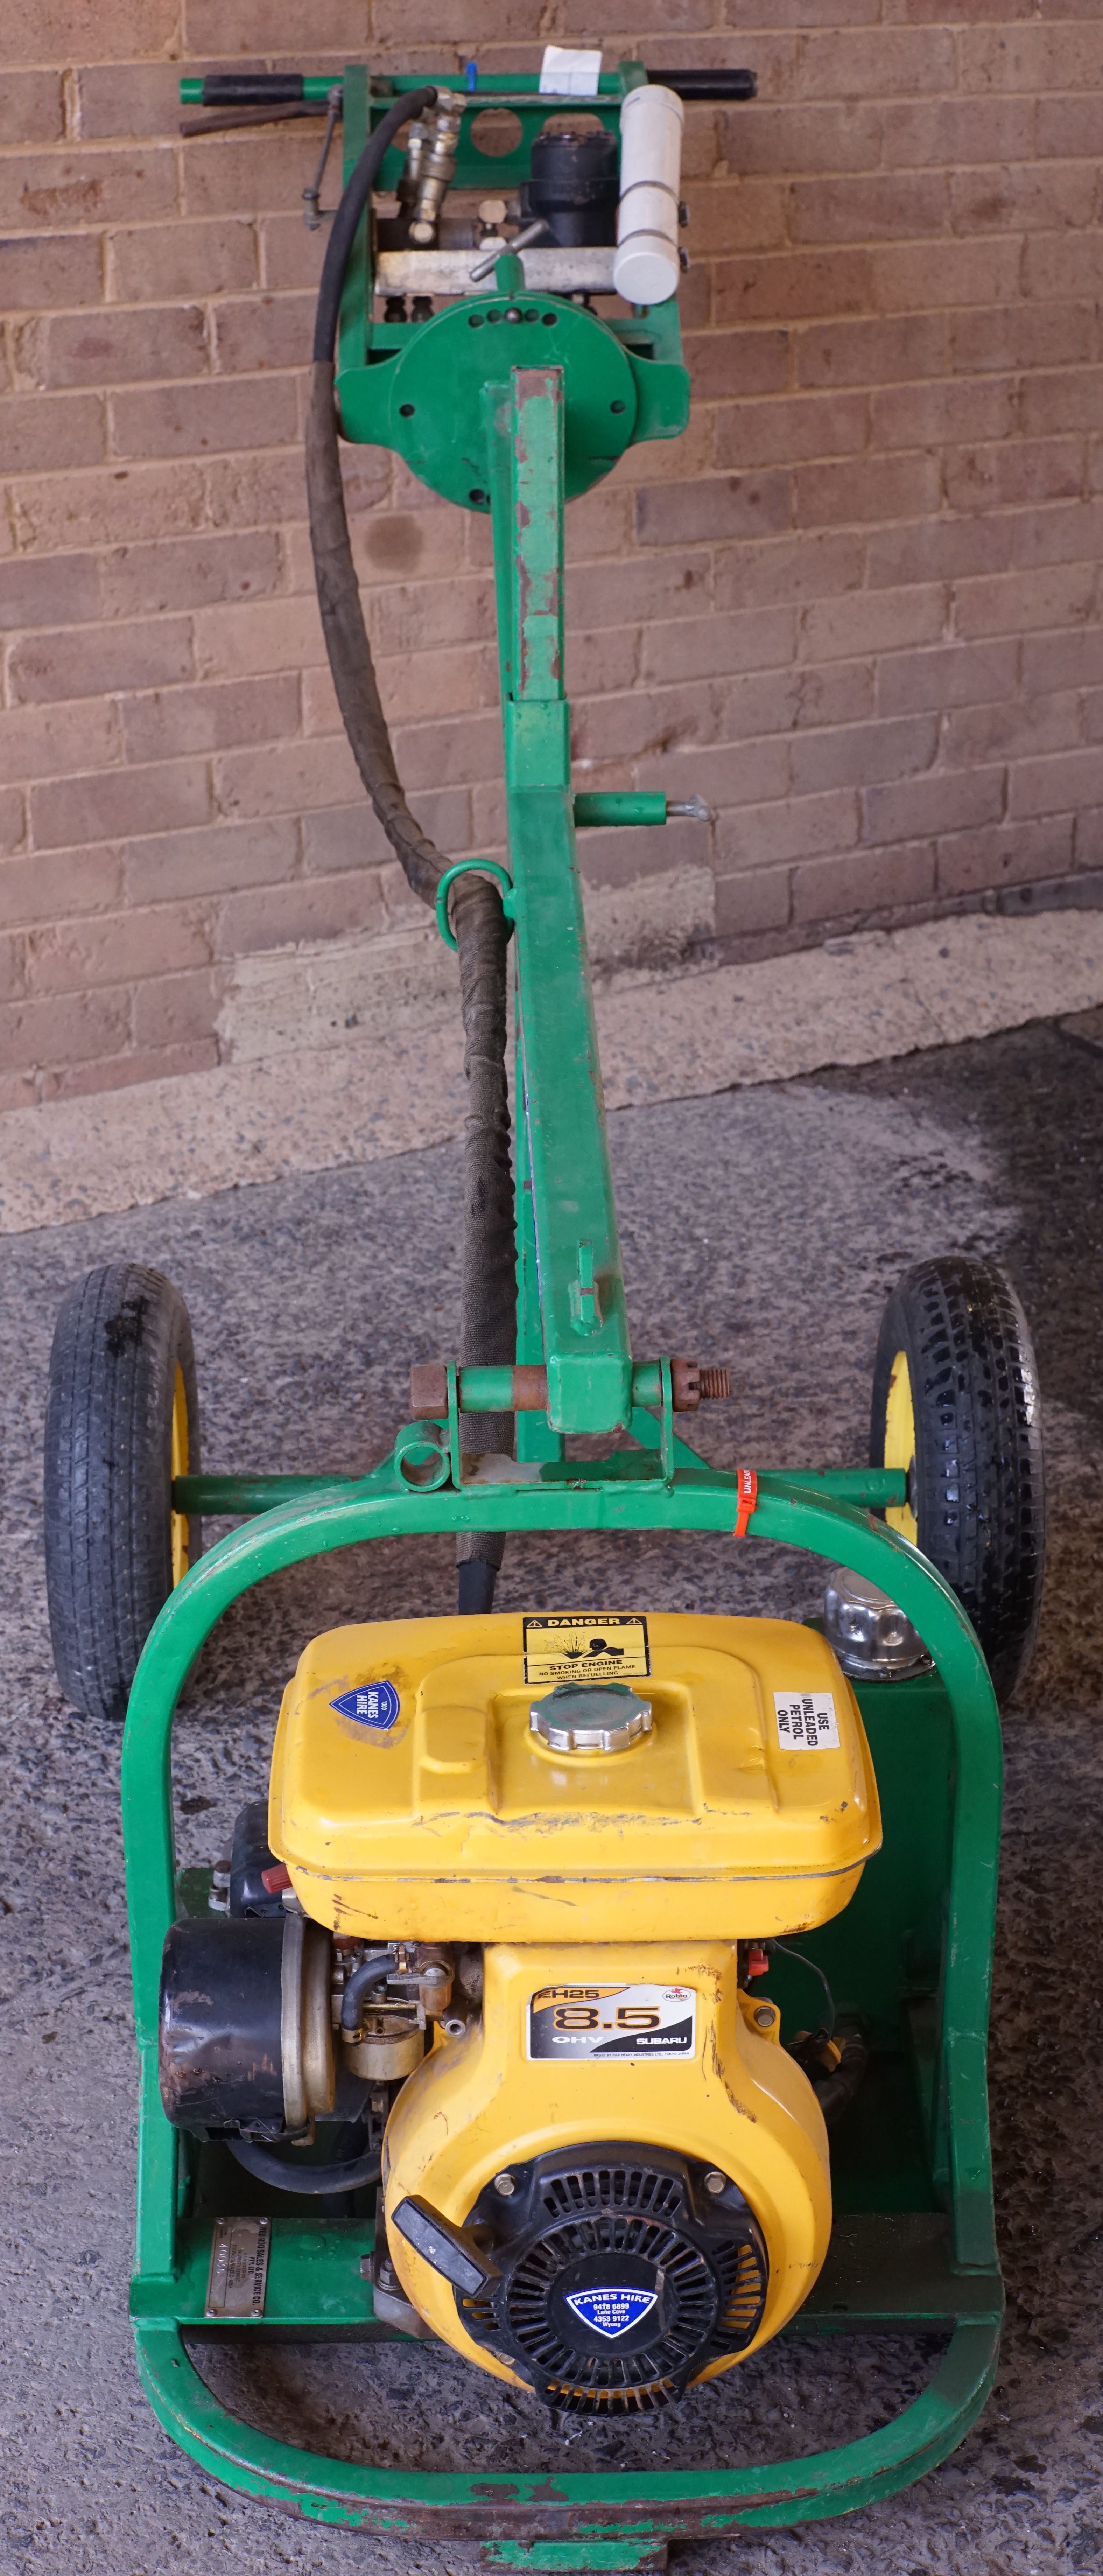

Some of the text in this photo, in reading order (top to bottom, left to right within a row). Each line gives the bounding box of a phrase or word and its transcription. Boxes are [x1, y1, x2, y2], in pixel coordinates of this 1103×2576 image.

[548, 1618, 620, 1626] DANGER
[581, 1660, 623, 1668] ENGINE
[357, 1695, 367, 1714] HIRE
[368, 1692, 379, 1718] KANES
[778, 1710, 790, 1732] ONLY
[790, 1704, 804, 1739] PETROL
[802, 1699, 818, 1746] UNLEADED
[817, 1713, 829, 1730] USE
[538, 1990, 599, 1998] EH25
[553, 2006, 661, 2031] 8.5
[256, 2249, 265, 2266] SALES
[253, 2273, 263, 2295] SERVICE
[252, 2296, 261, 2305] CO.
[574, 2294, 651, 2305] KANES HIRE
